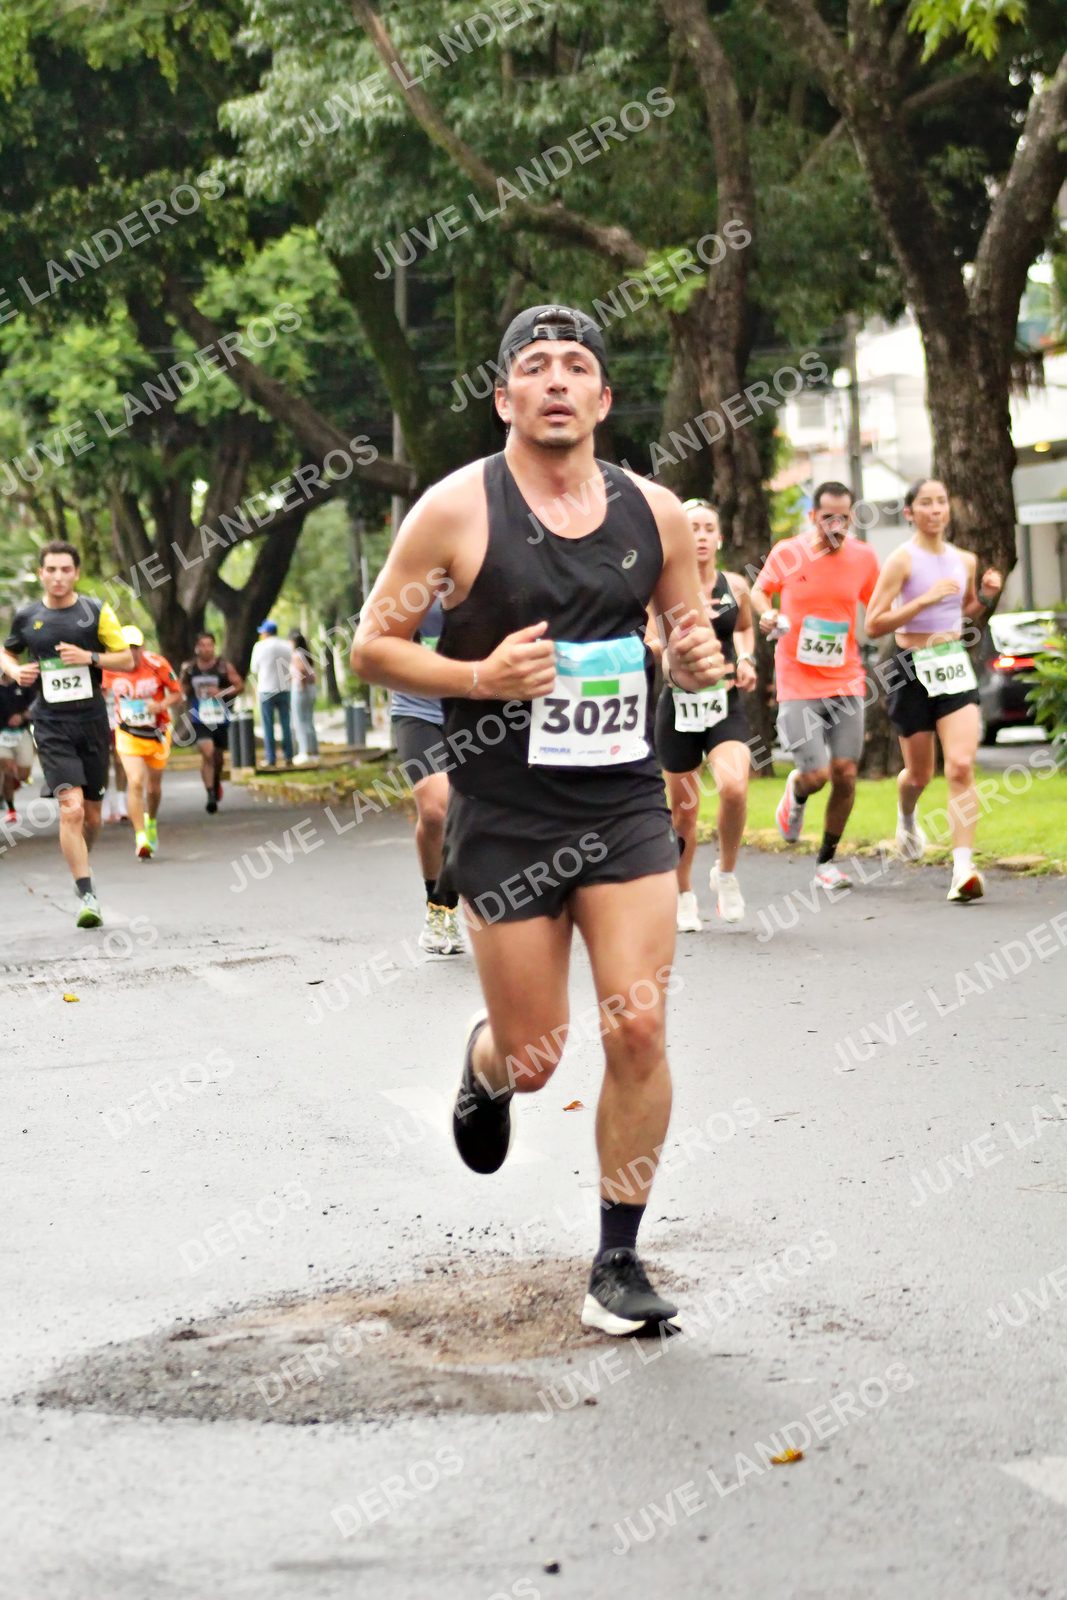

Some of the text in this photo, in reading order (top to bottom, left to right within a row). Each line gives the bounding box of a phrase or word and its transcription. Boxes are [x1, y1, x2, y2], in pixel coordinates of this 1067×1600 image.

[802, 638, 843, 655] 3474
[922, 663, 967, 683] 1608
[52, 675, 82, 691] 952
[541, 695, 639, 736] 3023
